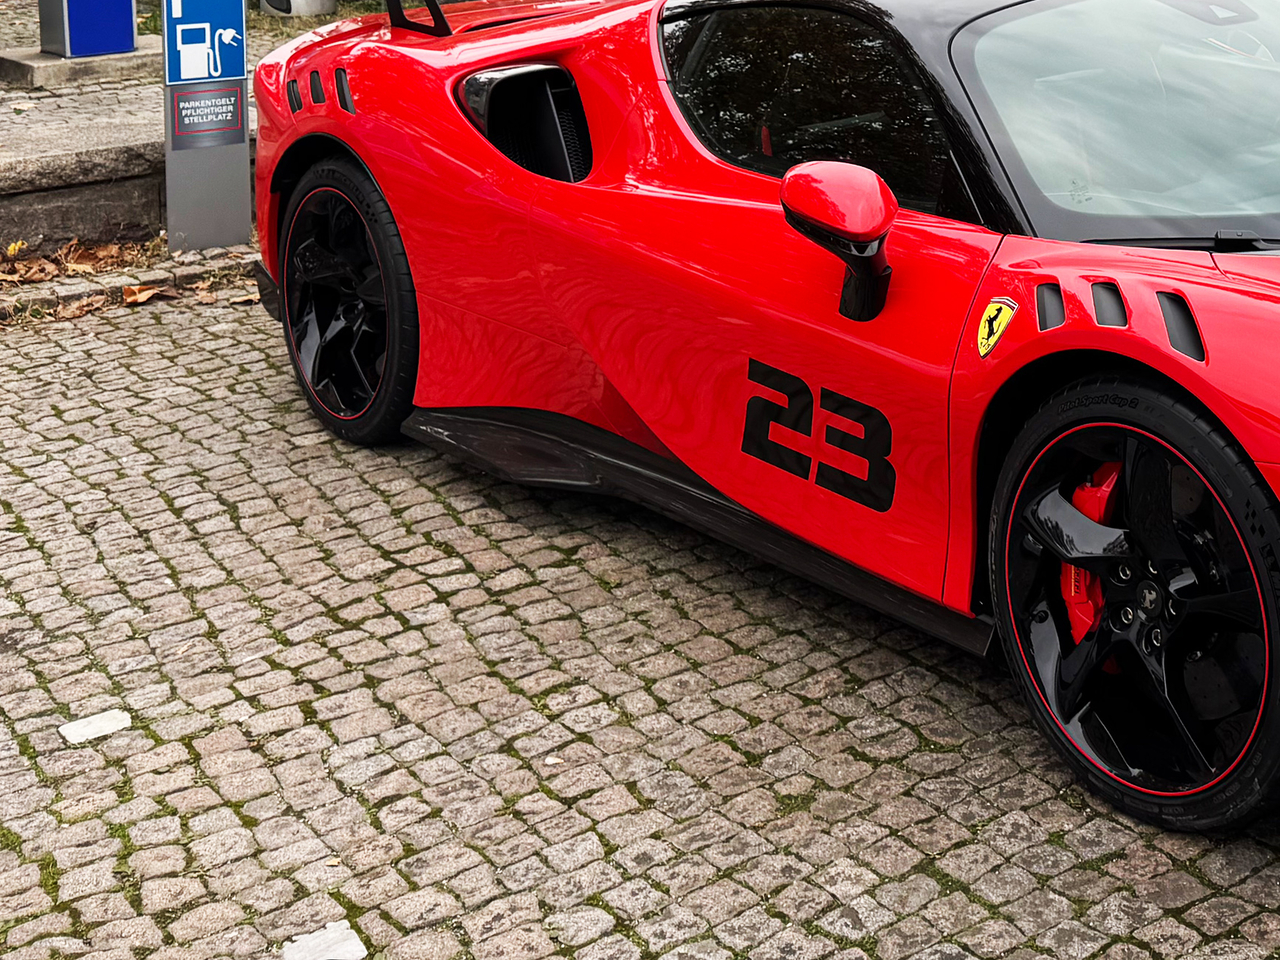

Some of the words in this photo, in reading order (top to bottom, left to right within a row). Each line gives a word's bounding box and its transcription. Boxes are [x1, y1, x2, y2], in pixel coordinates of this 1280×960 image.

[179, 97, 236, 109] PARKENTGELT
[181, 105, 234, 117] PFLICHTIGER
[184, 113, 233, 124] STELLPLATZ
[1058, 399, 1080, 412] Pilot
[1080, 394, 1109, 407] Sport
[1109, 394, 1128, 407] Cup
[1129, 398, 1139, 408] 2
[740, 357, 897, 513] 23
